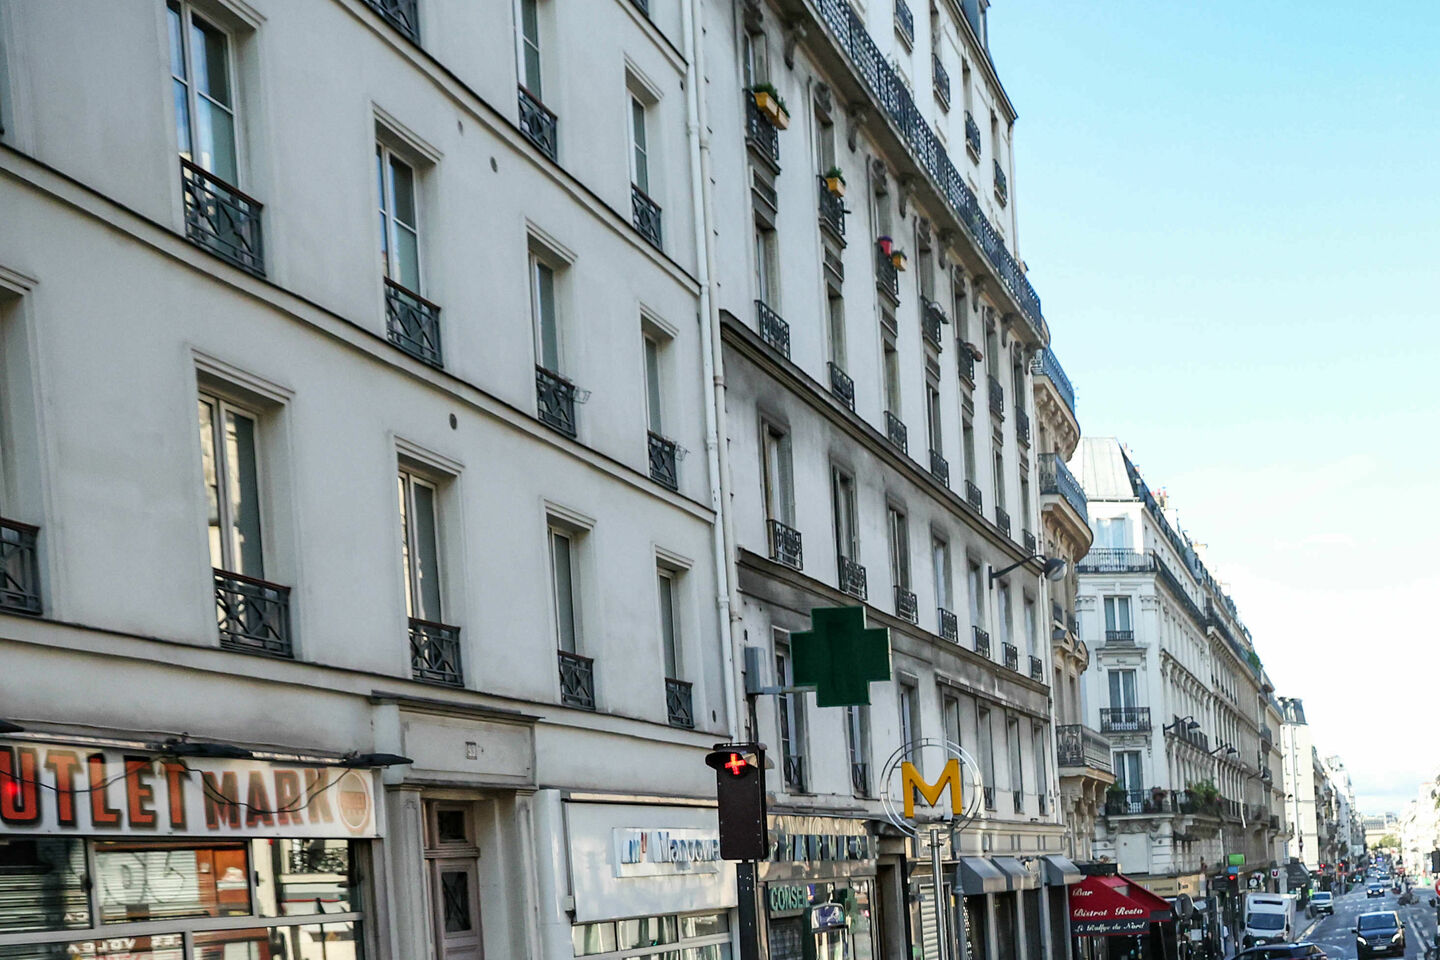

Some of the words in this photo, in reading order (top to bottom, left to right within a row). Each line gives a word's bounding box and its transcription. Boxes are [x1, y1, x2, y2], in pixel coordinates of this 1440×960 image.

[203, 767, 335, 830] MARK
[902, 758, 962, 818] M
[1072, 888, 1093, 896] Bar
[1074, 908, 1108, 917] Bistrot
[1114, 906, 1144, 916] Resto
